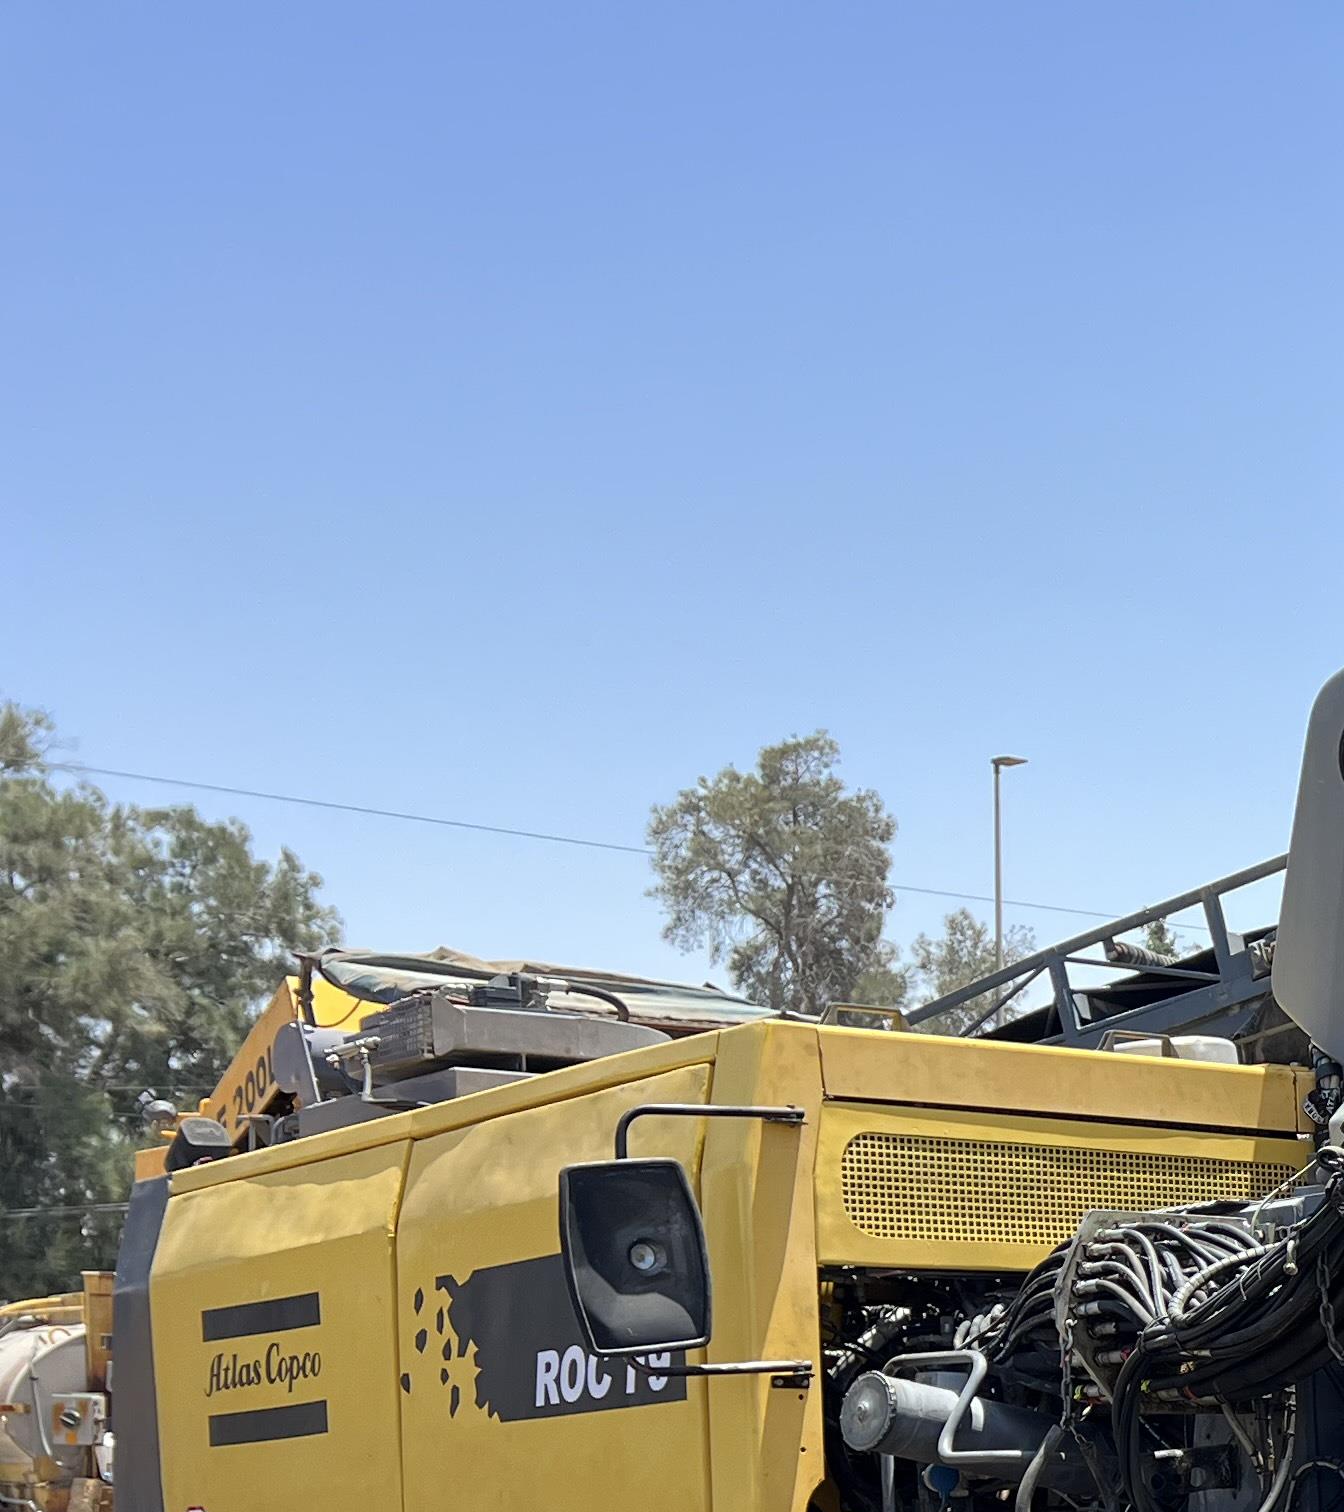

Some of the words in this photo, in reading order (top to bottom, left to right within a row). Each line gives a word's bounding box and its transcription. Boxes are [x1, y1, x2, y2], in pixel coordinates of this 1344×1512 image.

[204, 1353, 262, 1398] Atlas
[265, 1342, 321, 1393] Copco
[535, 1344, 613, 1408] ROC
